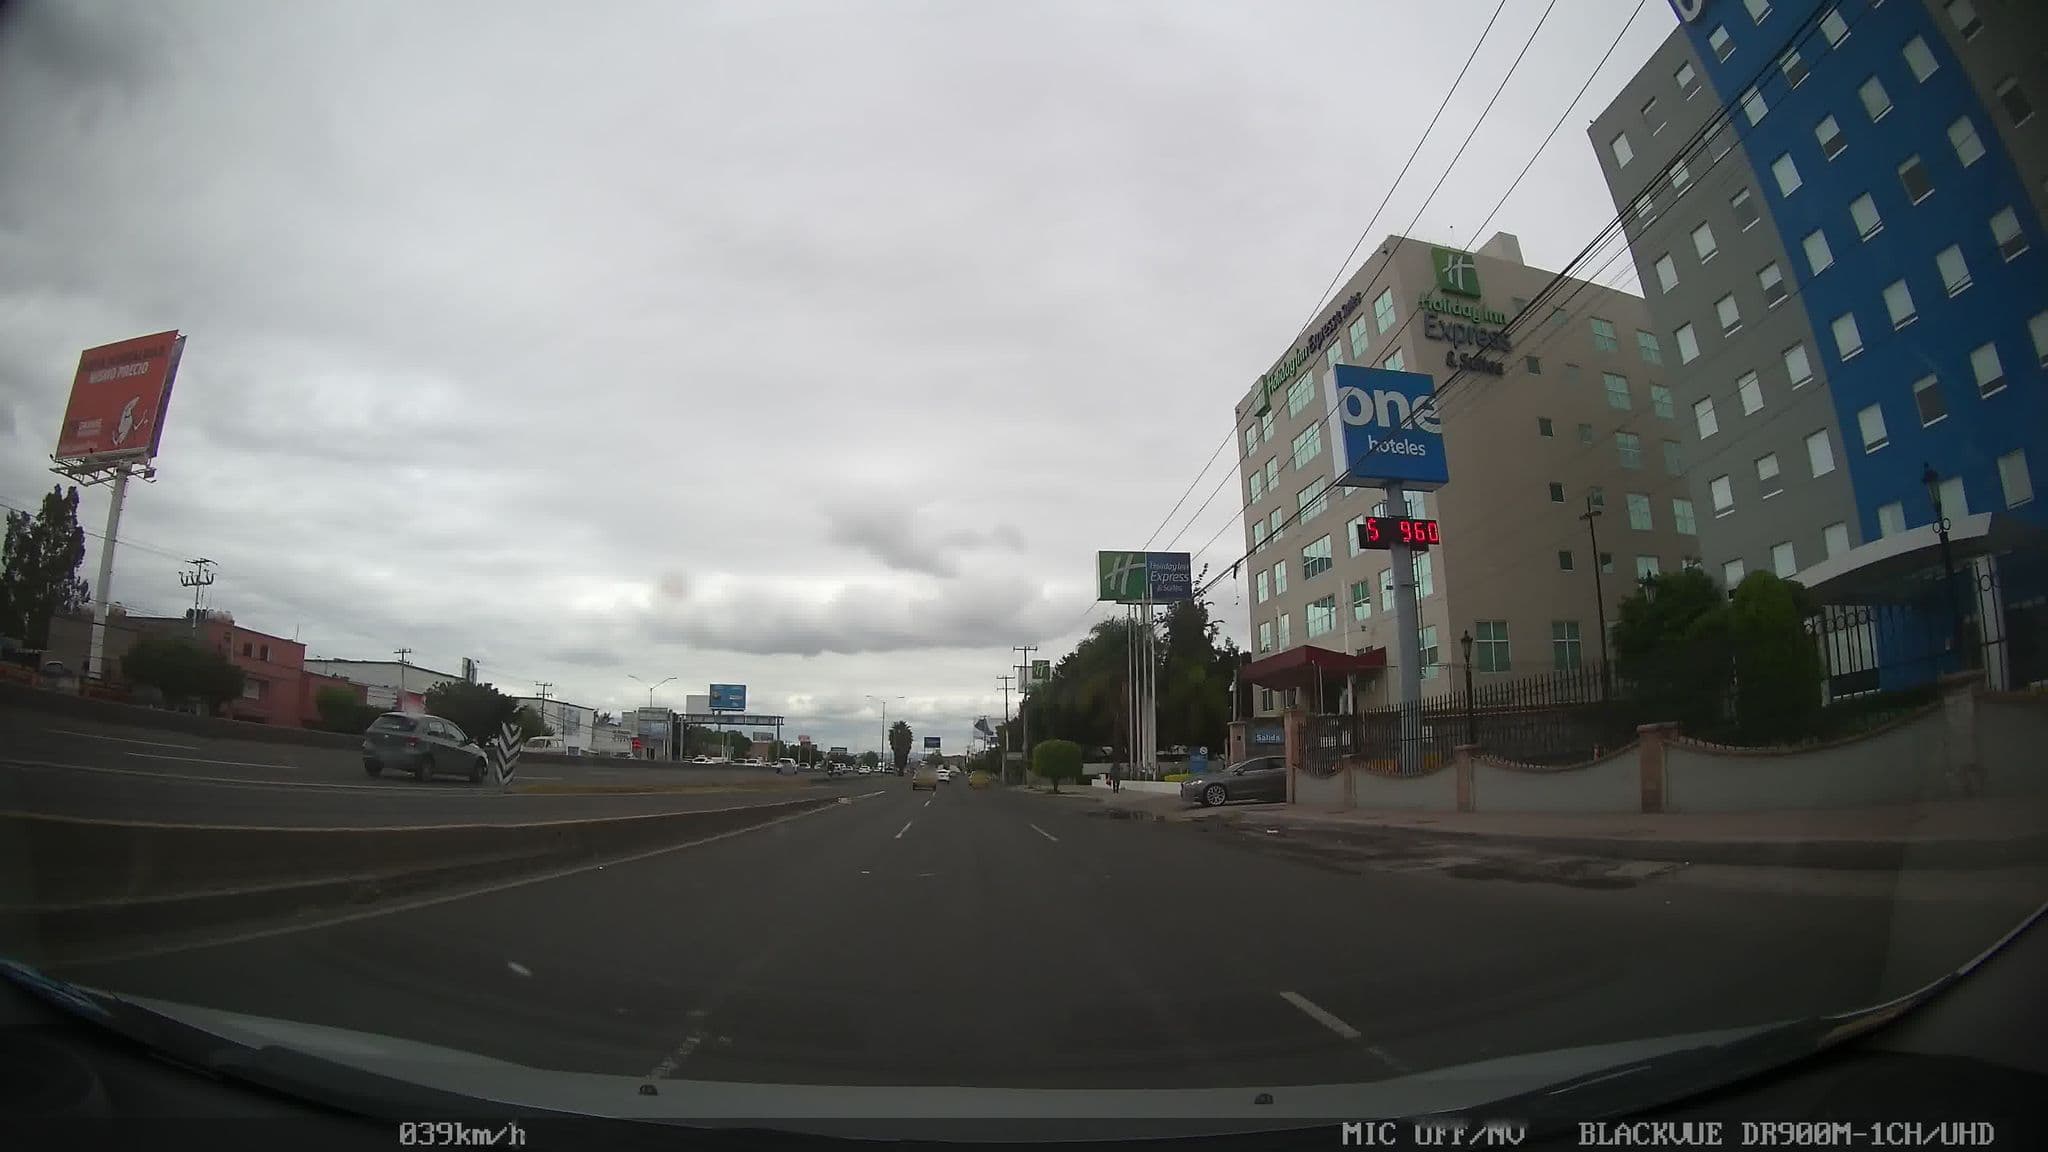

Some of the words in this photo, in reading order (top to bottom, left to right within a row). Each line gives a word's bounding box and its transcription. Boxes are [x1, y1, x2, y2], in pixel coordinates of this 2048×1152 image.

[1418, 297, 1481, 324] Holiday
[1424, 312, 1513, 353] Express
[117, 361, 149, 379] PRECIO
[1446, 350, 1458, 369] &
[1460, 352, 1505, 376] Suites
[1338, 386, 1443, 434] one
[1368, 434, 1426, 456] hoteles
[1400, 521, 1439, 543] 960
[1150, 570, 1189, 584] Express
[1256, 734, 1280, 742] Salida
